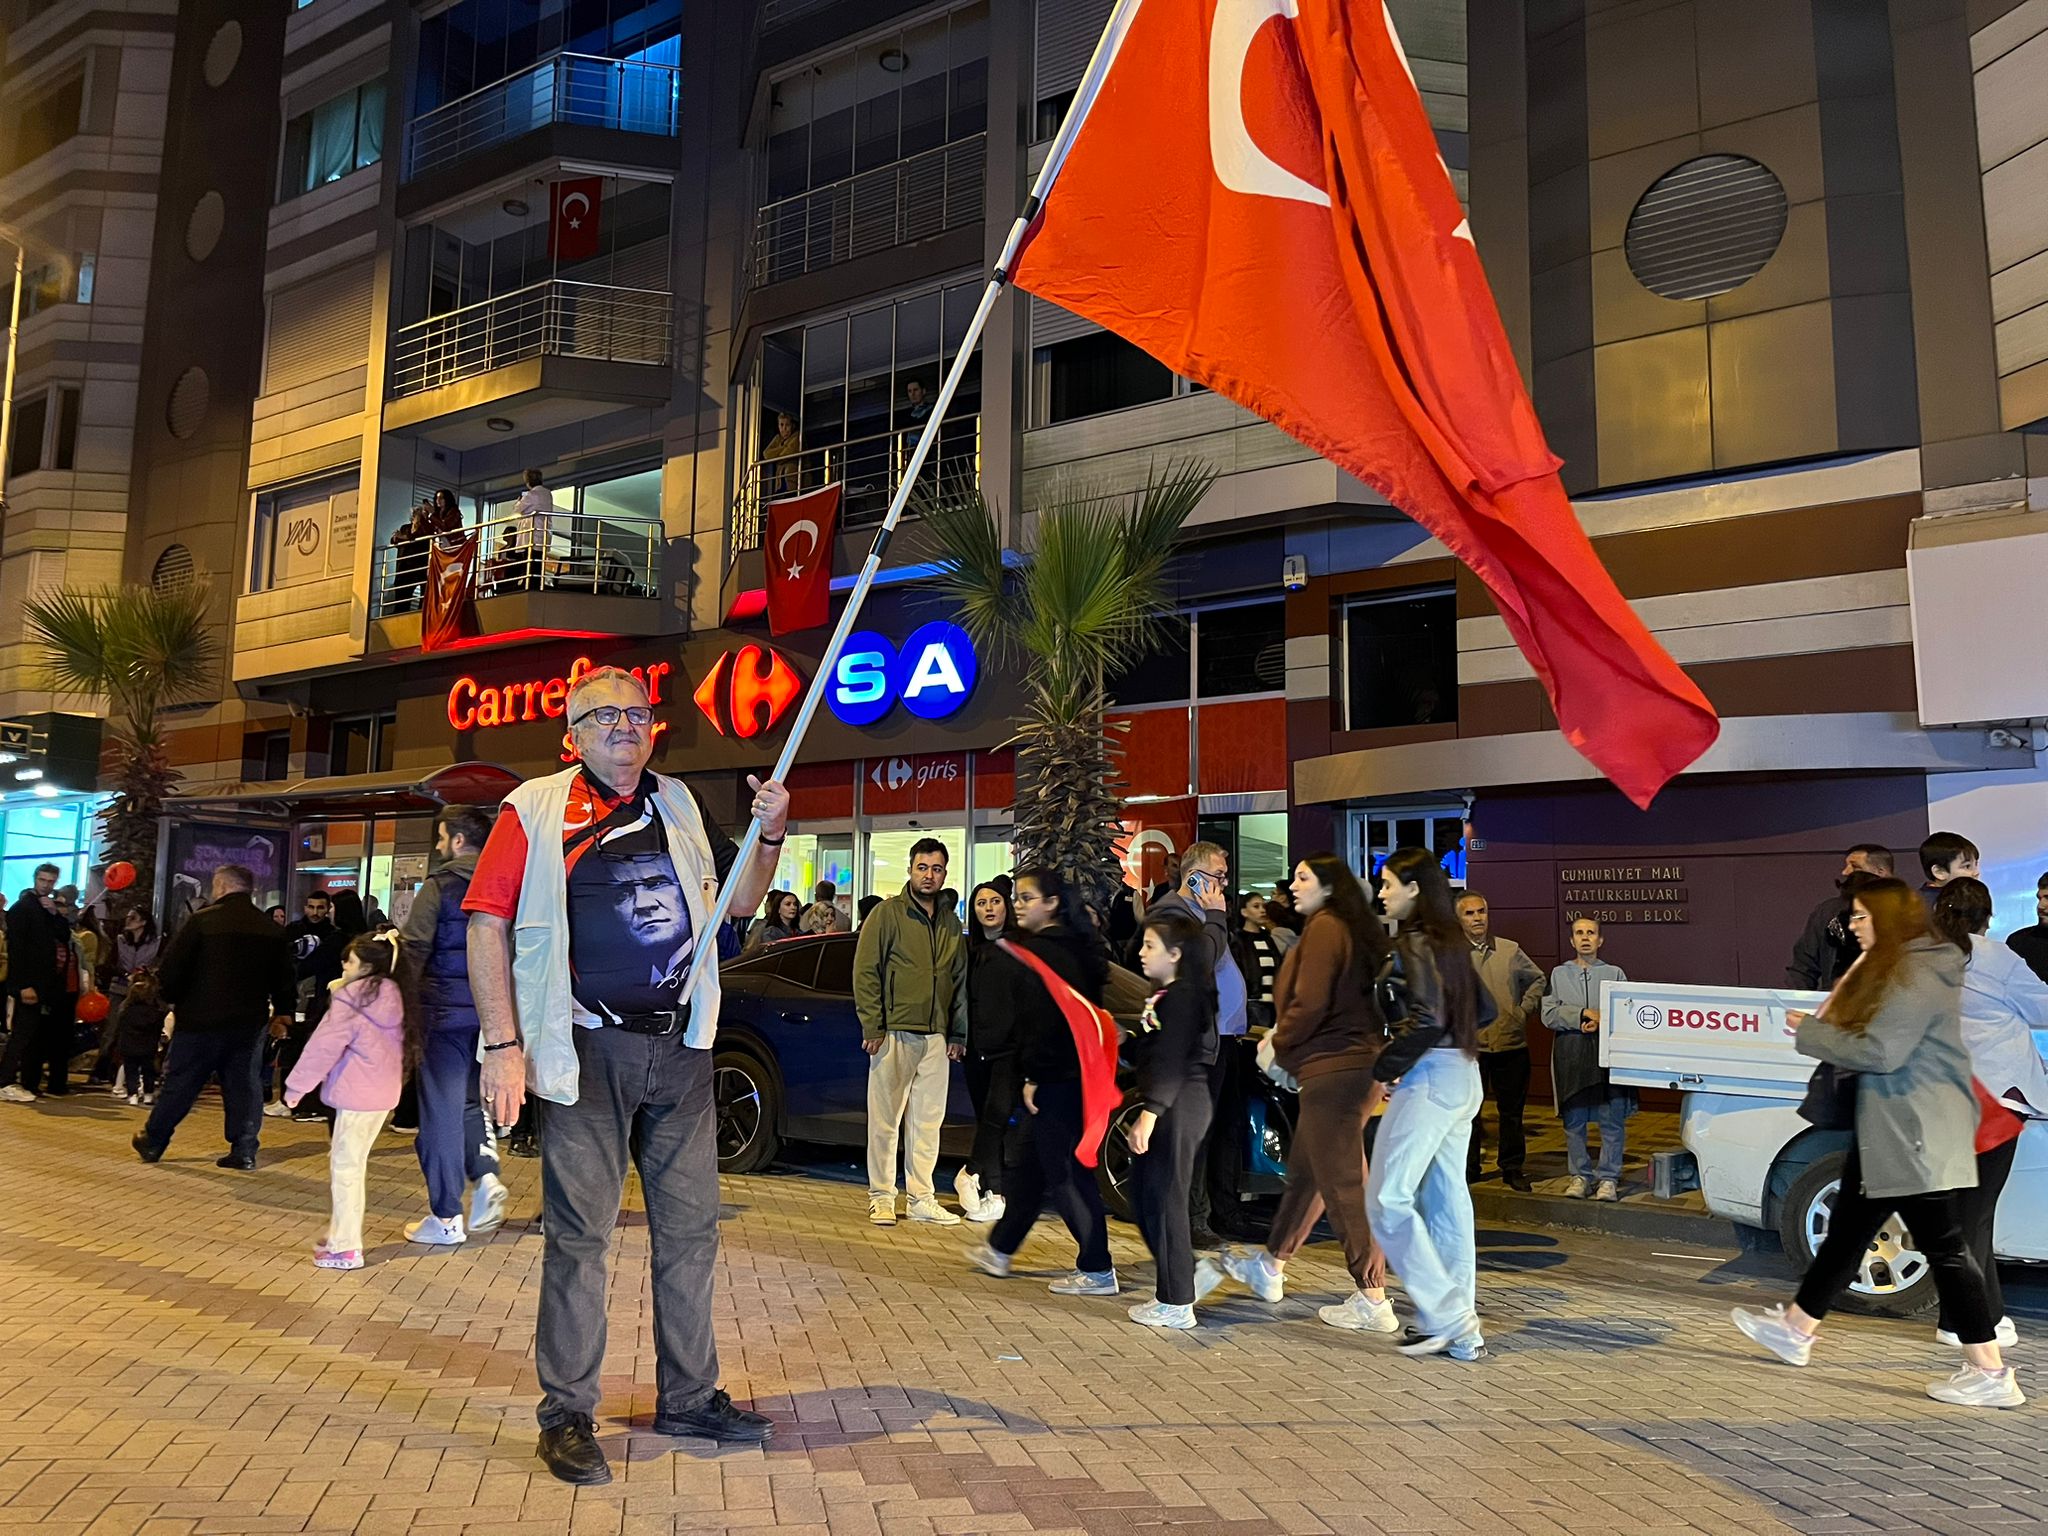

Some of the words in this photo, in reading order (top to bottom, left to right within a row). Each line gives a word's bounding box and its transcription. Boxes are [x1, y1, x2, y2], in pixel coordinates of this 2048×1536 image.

[447, 656, 670, 731] Carrefr
[917, 760, 958, 789] giriş
[1651, 866, 1680, 880] MAH
[1593, 910, 1617, 921] 250
[1626, 910, 1633, 922] B
[1644, 909, 1683, 922] BLOK
[1667, 1008, 1759, 1033] BOSCH
